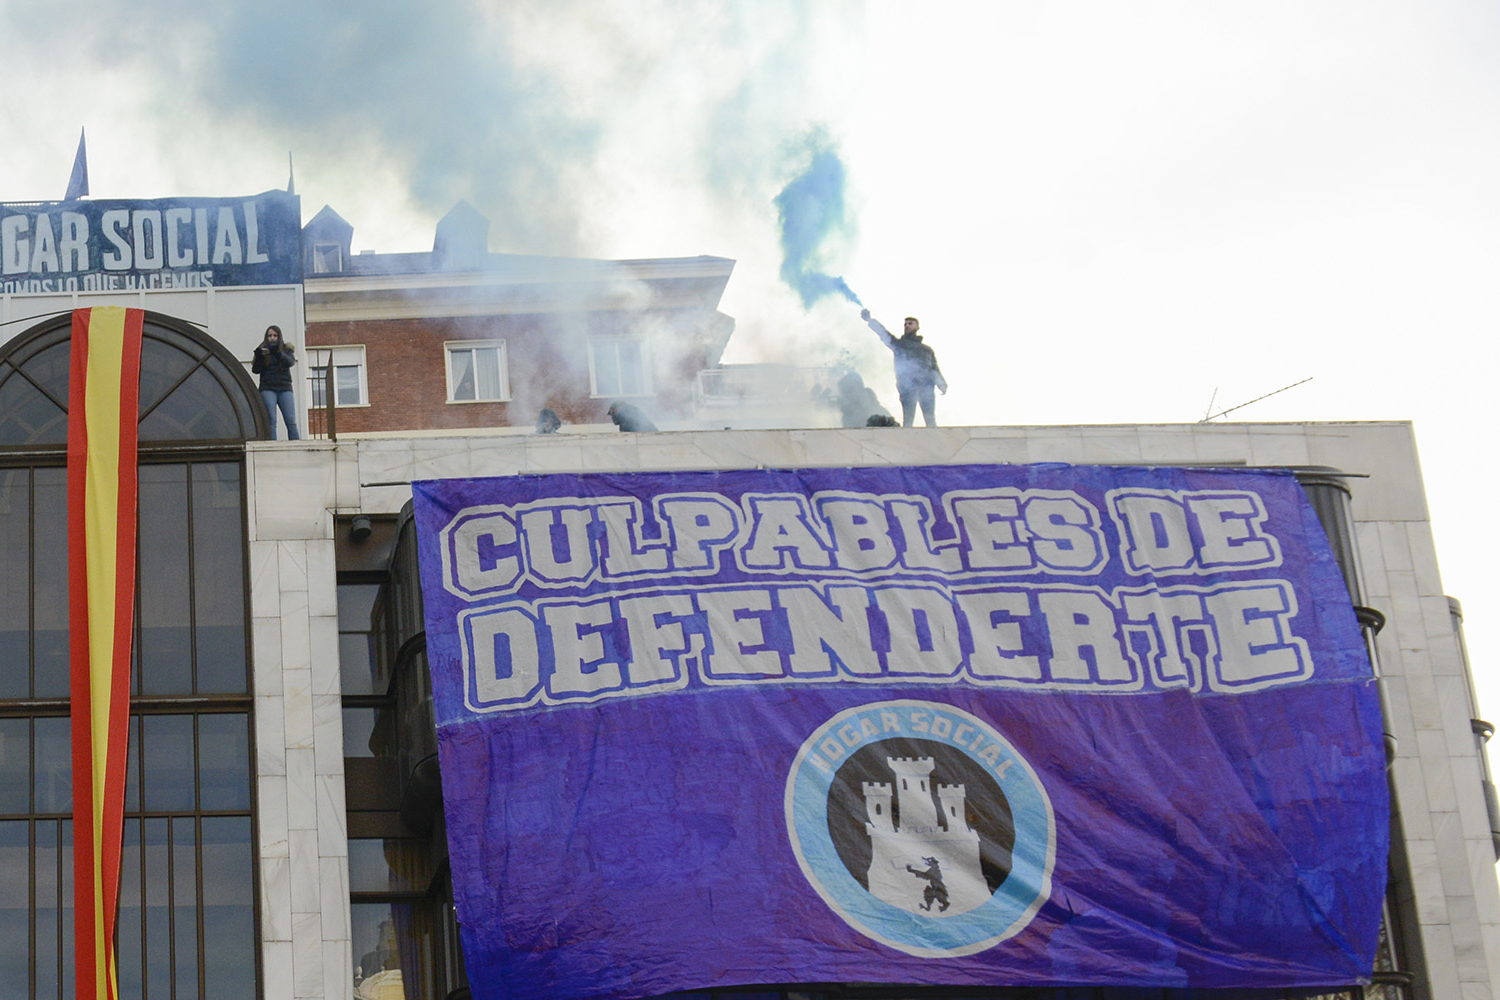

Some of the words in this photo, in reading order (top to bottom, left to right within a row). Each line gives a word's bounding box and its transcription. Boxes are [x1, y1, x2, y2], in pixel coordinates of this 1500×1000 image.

[101, 202, 269, 271] SOCIAL
[454, 497, 1097, 592] CULPABLES
[1114, 497, 1275, 569] DE
[469, 584, 1300, 703] DEFENDERTE
[810, 712, 900, 773] HOGAR
[910, 711, 1014, 779] SOCIAL
